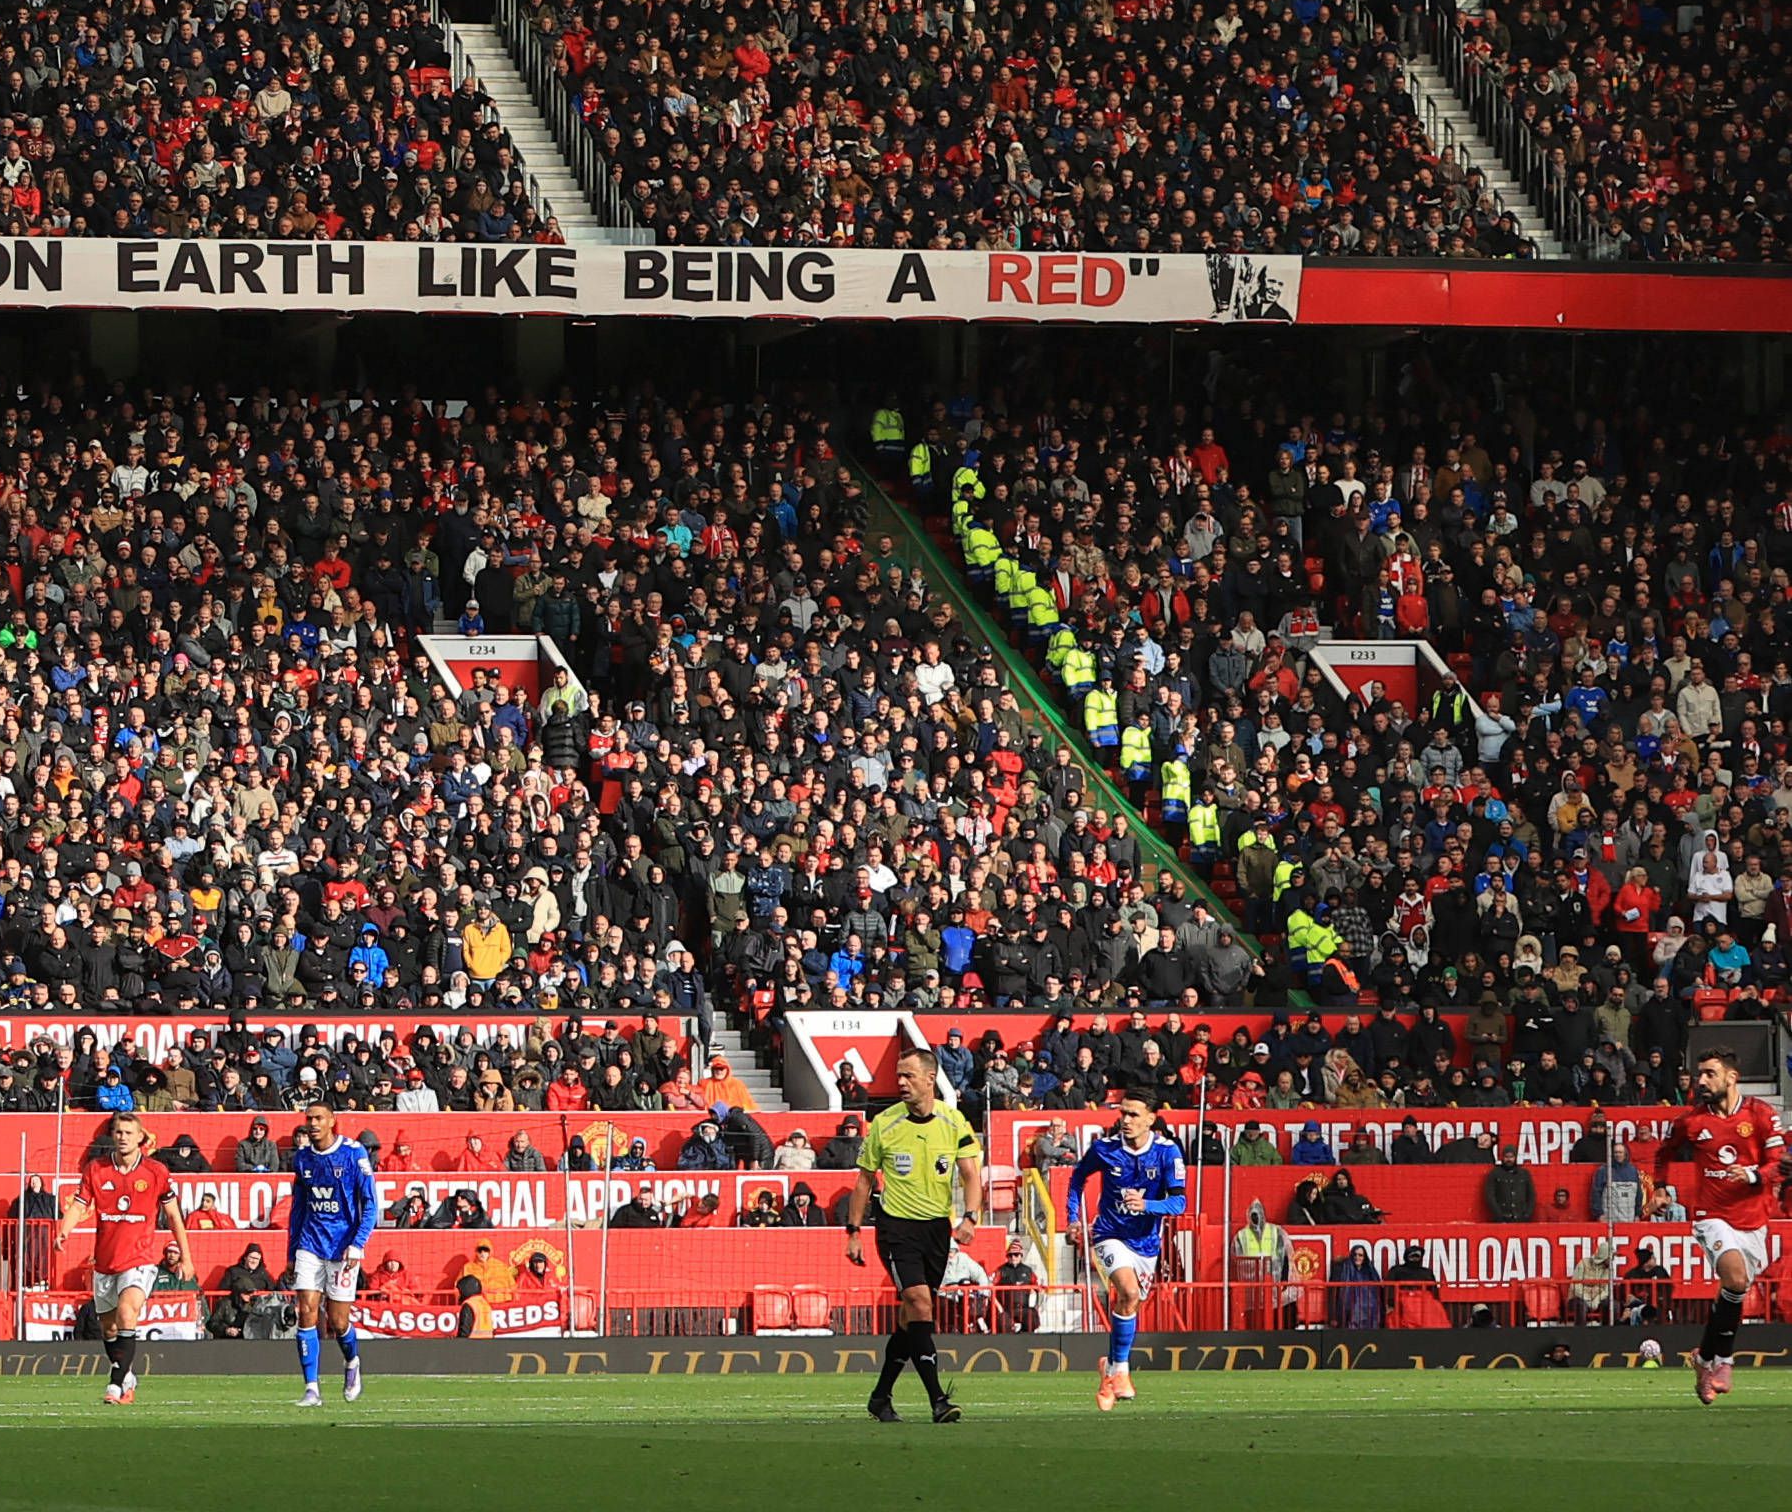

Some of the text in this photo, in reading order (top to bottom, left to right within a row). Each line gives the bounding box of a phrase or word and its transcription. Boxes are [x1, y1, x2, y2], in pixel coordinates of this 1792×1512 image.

[117, 242, 364, 295] EARTH
[418, 247, 577, 299] LIKE
[624, 250, 834, 303] BEING
[887, 253, 936, 303] A
[987, 254, 1161, 307] RED"
[469, 646, 496, 656] E234
[1350, 651, 1376, 661] E233
[832, 1020, 861, 1030] E134
[310, 1201, 340, 1213] W88
[333, 1271, 353, 1289] 18
[350, 1300, 560, 1333] GLASGO REDS
